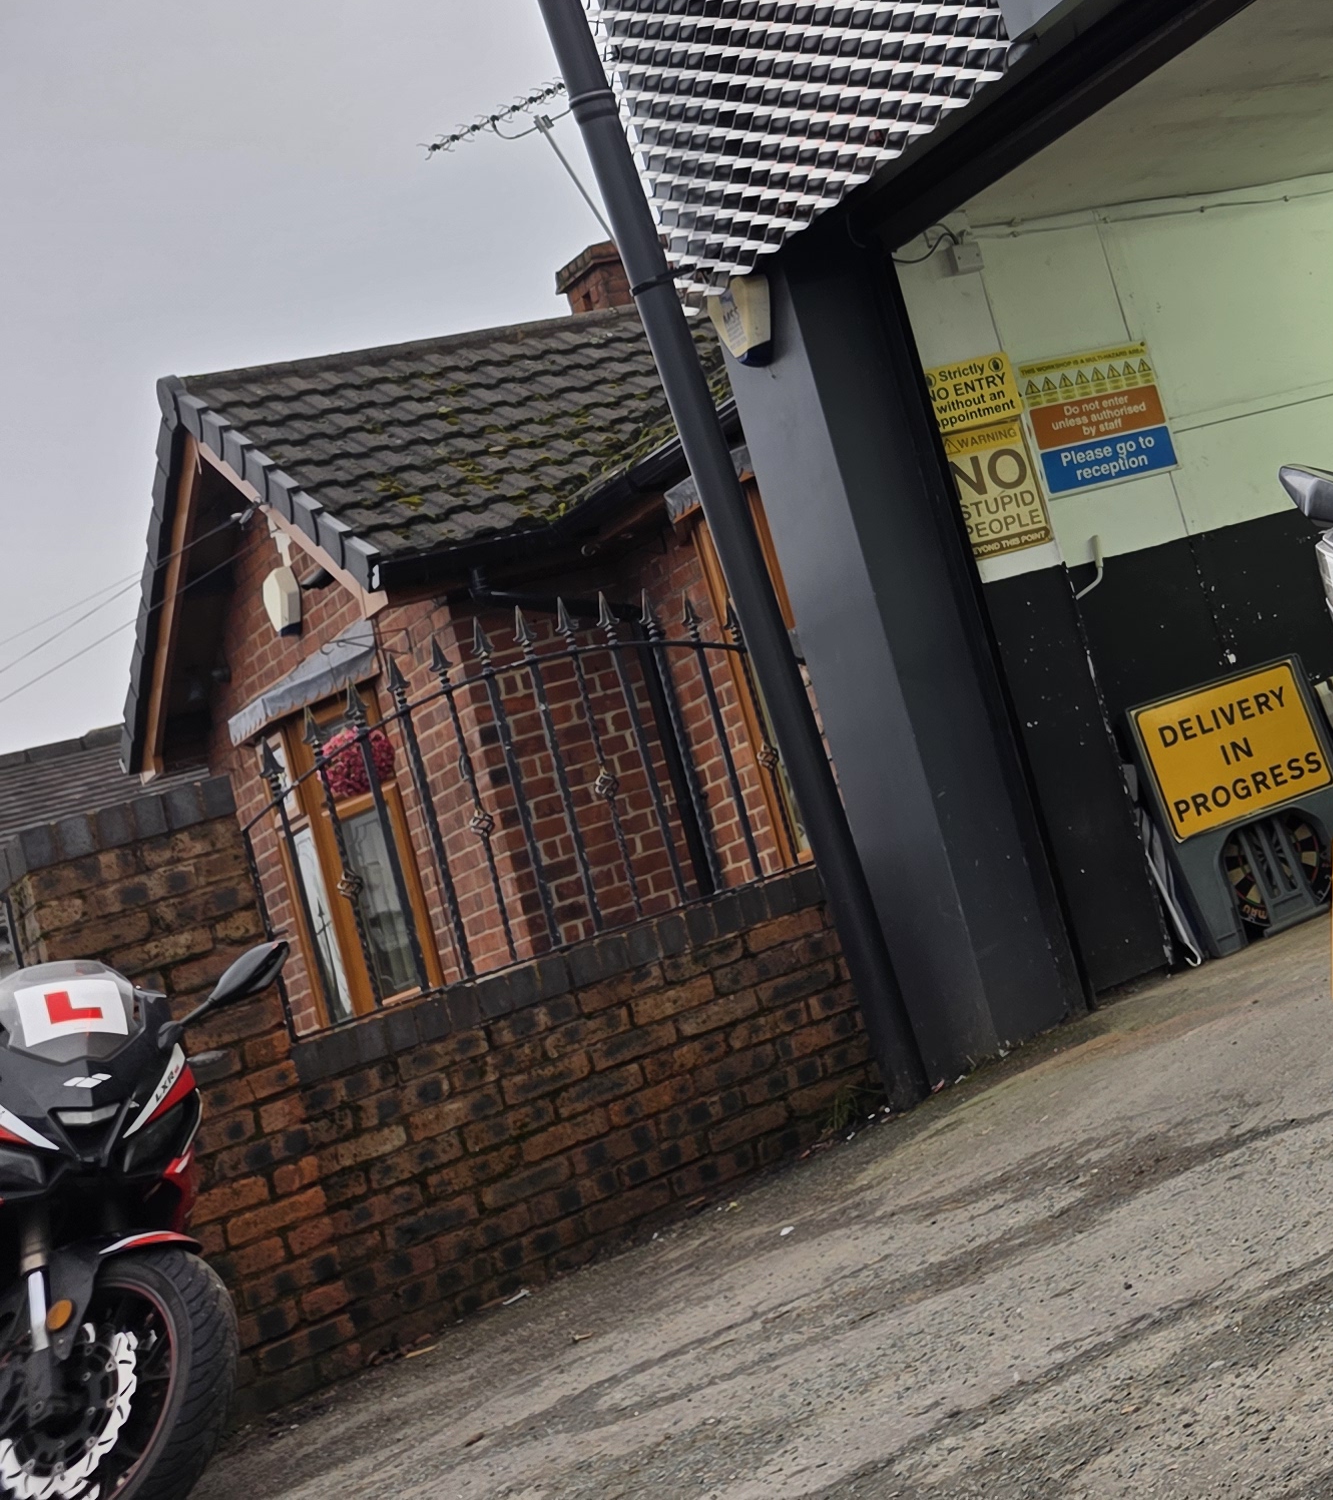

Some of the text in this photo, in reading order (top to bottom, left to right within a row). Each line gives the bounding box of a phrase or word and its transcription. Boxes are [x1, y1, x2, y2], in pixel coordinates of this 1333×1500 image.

[938, 362, 985, 382] Strictly
[953, 371, 1006, 397] ENTRY
[936, 389, 1006, 415] without an
[938, 398, 1016, 429] ppointment
[1051, 401, 1147, 431] unless authorised
[1063, 405, 1080, 416] Do
[1081, 400, 1100, 414] not
[1101, 394, 1129, 409] enter
[957, 427, 1017, 449] WARNING
[1082, 418, 1123, 437] by staff
[1060, 435, 1155, 467] Please go to
[949, 448, 1027, 496] NO
[1076, 454, 1149, 481] reception
[960, 489, 1035, 521] STUPID
[1001, 535, 1020, 549] THIS
[1022, 530, 1046, 544] POINT
[1157, 685, 1285, 749] DELIVERY
[1220, 736, 1254, 766] IN
[1173, 751, 1323, 823] PROGRESS
[44, 990, 104, 1025] L
